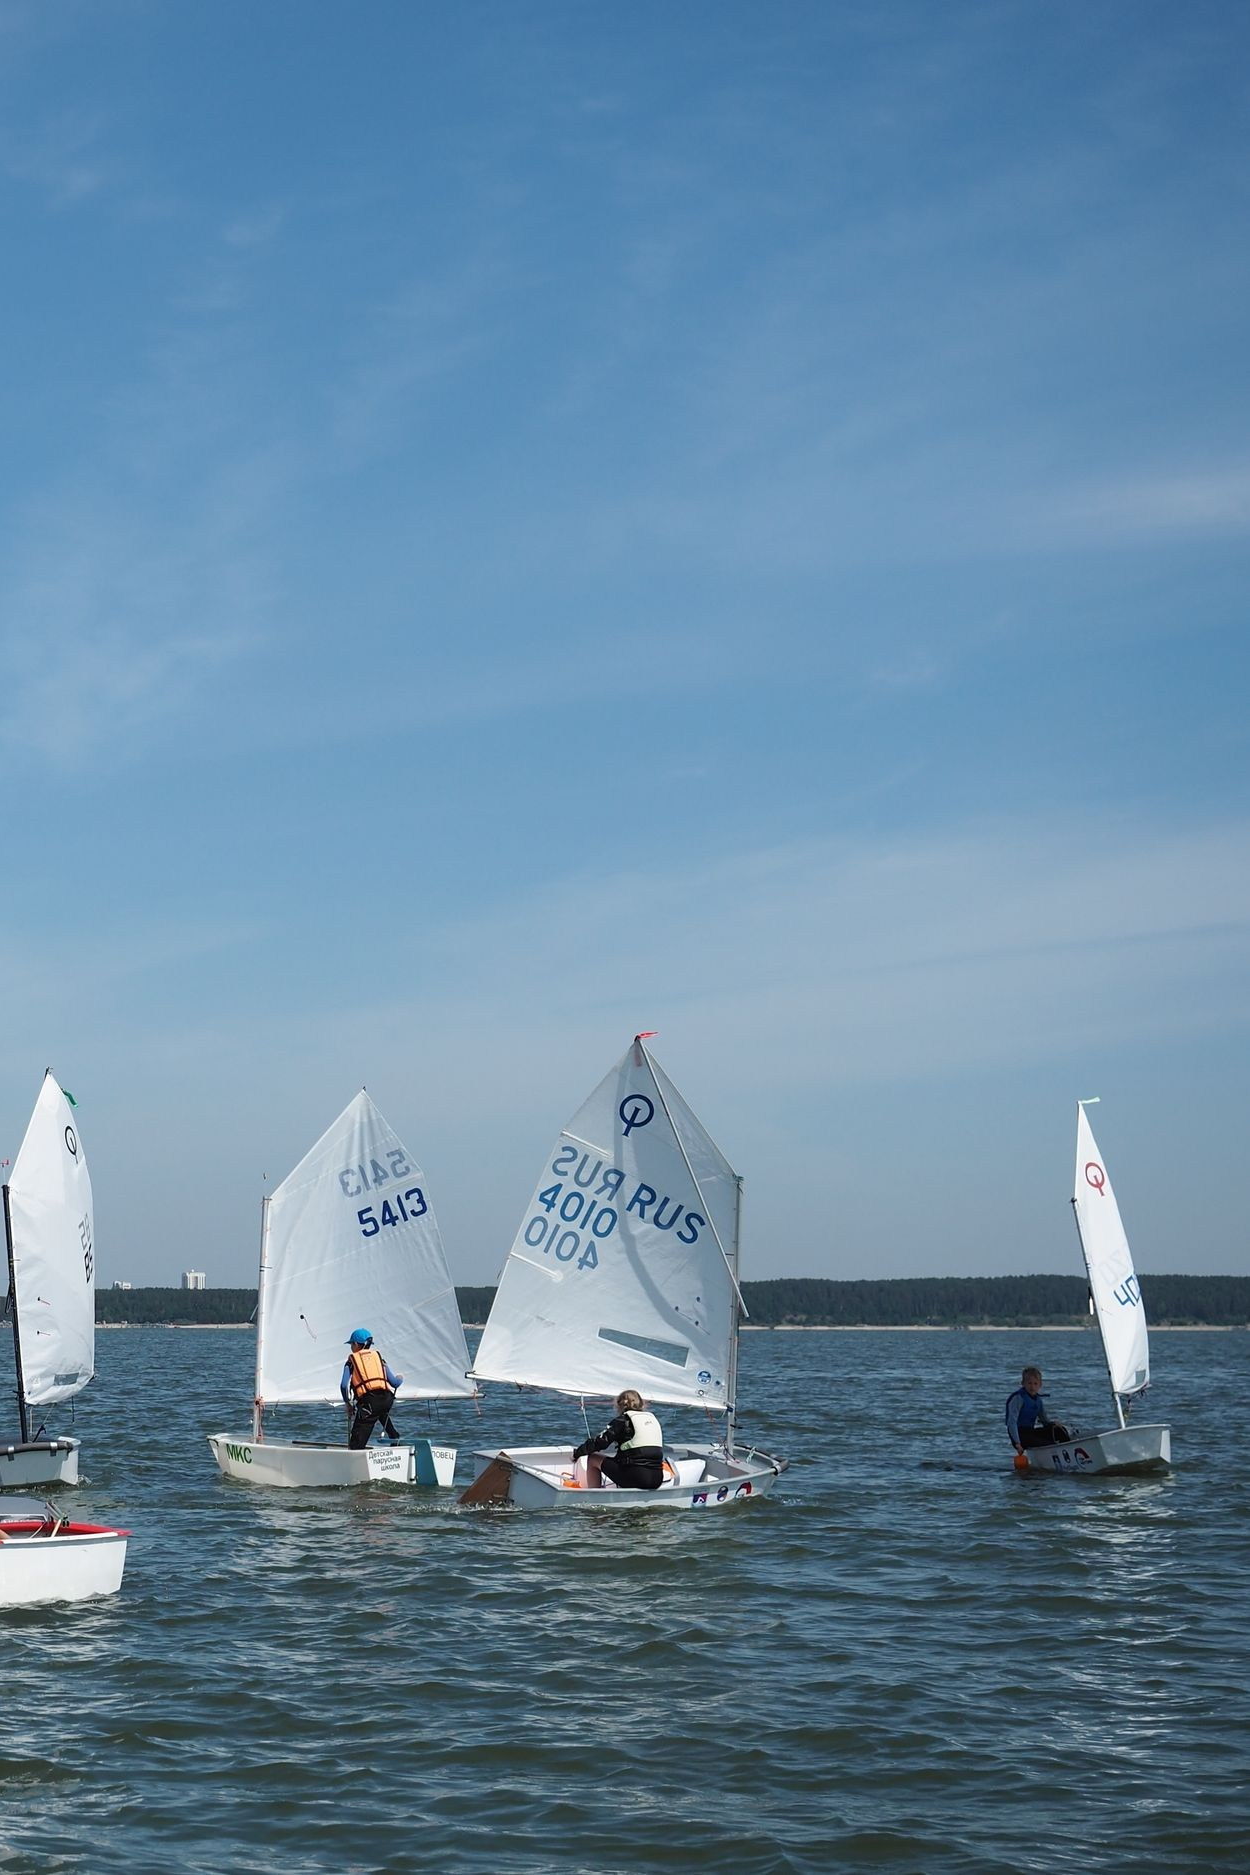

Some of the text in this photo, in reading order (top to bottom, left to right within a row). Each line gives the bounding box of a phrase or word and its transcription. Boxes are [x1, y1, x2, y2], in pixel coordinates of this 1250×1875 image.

[357, 1187, 428, 1237] 5413
[538, 1183, 618, 1238] 4010
[626, 1183, 706, 1244] RUS
[368, 1449, 394, 1459] Детская
[373, 1455, 402, 1465] парусная
[380, 1463, 401, 1471] школа
